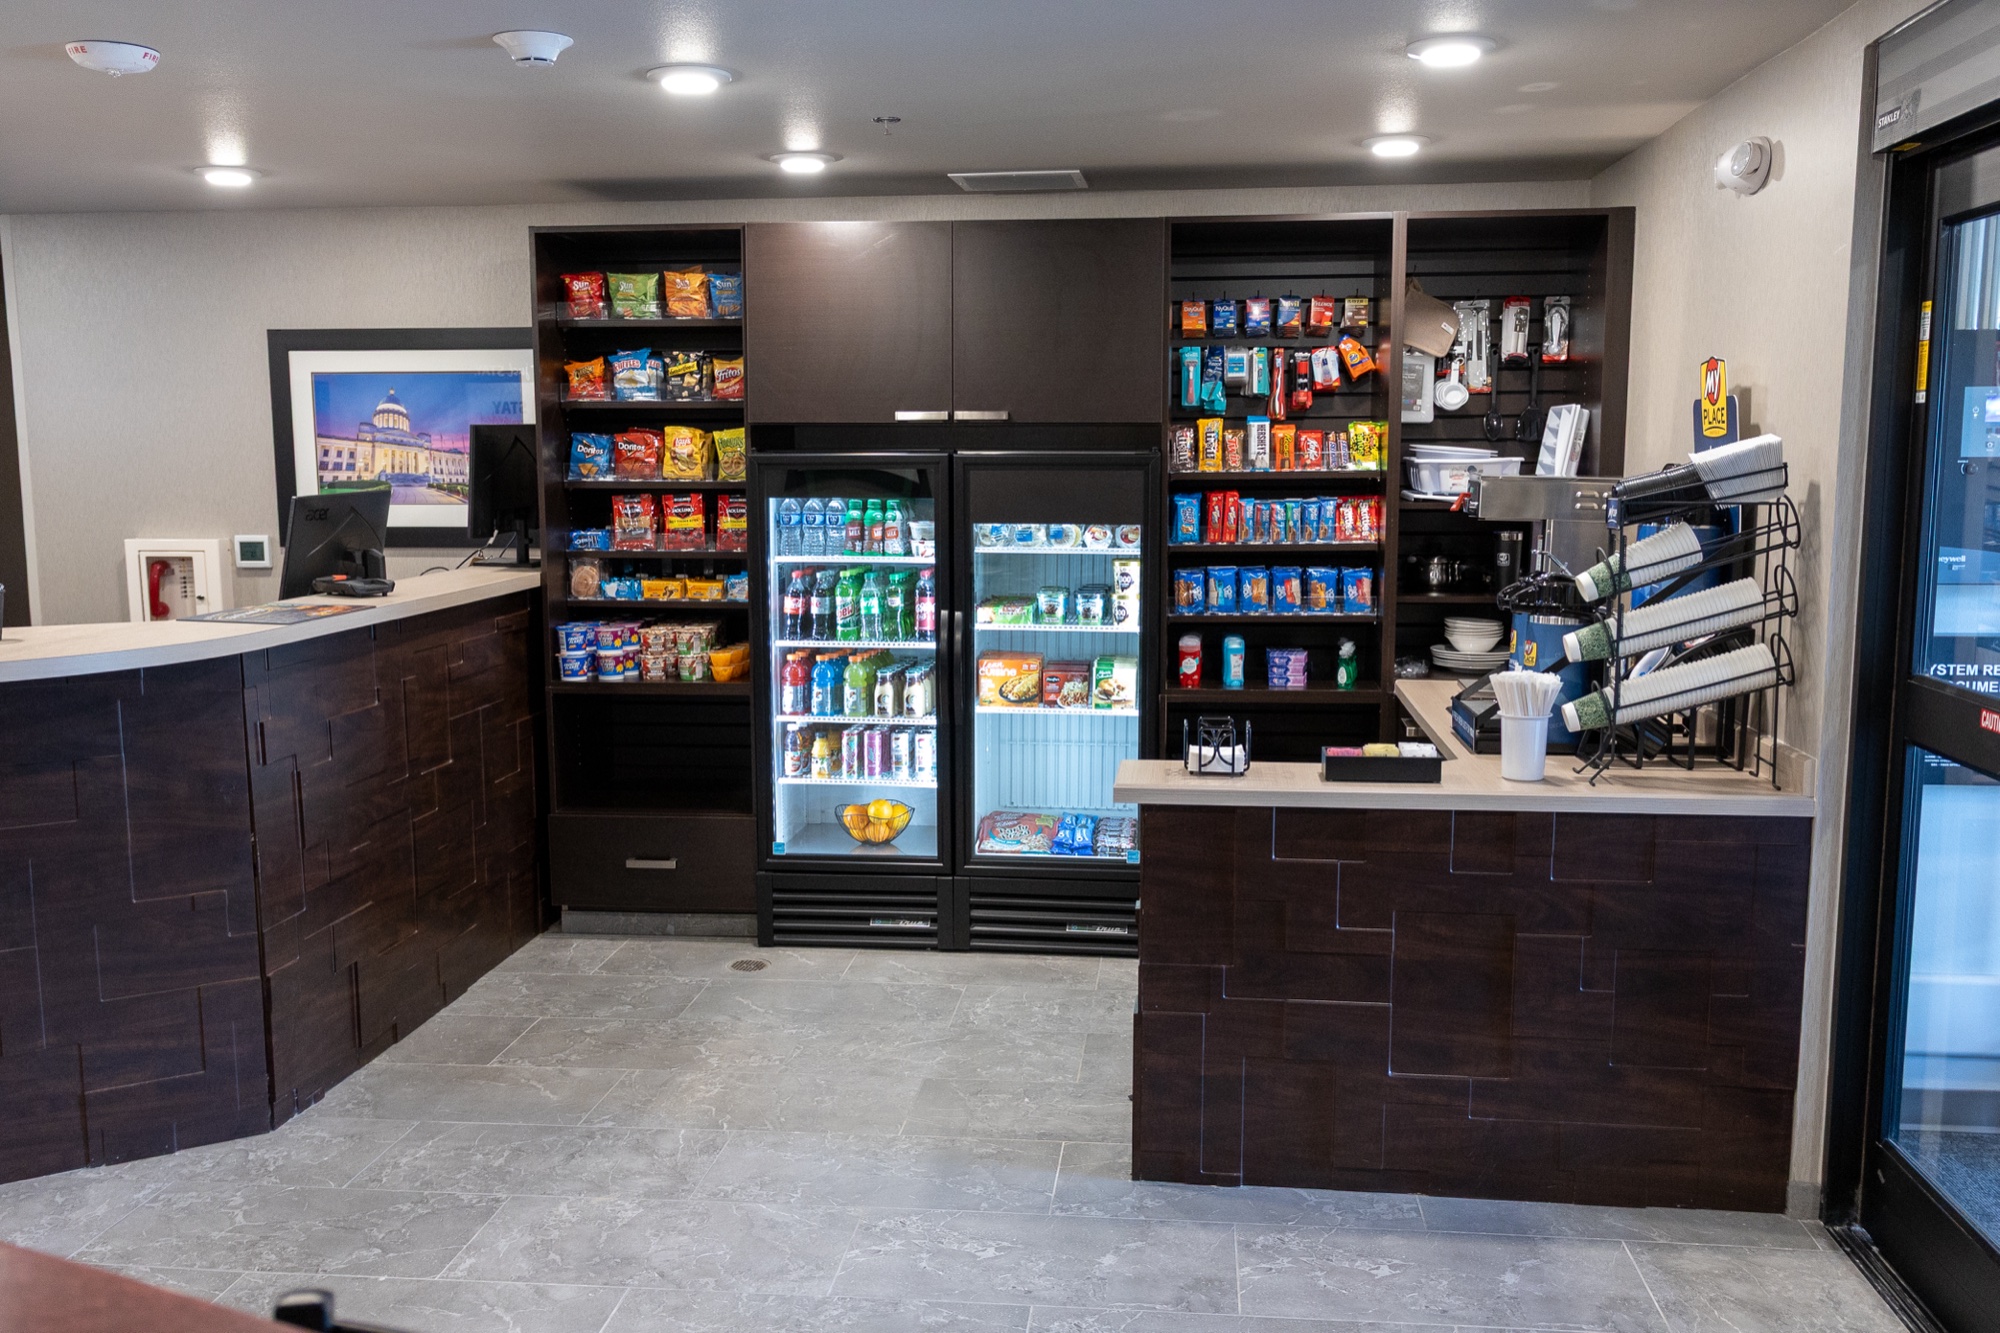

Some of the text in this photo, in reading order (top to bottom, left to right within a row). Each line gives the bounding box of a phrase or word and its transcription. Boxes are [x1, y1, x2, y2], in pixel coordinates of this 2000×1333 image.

[68, 45, 88, 56] FIRE
[1878, 109, 1900, 129] STANLEY
[572, 280, 590, 291] Sun
[716, 280, 732, 289] Sun
[716, 368, 741, 381] Fritos
[1704, 360, 1721, 400] MY
[1703, 407, 1726, 425] PLACE
[577, 444, 604, 455] Doritos
[618, 441, 645, 452] Doritos
